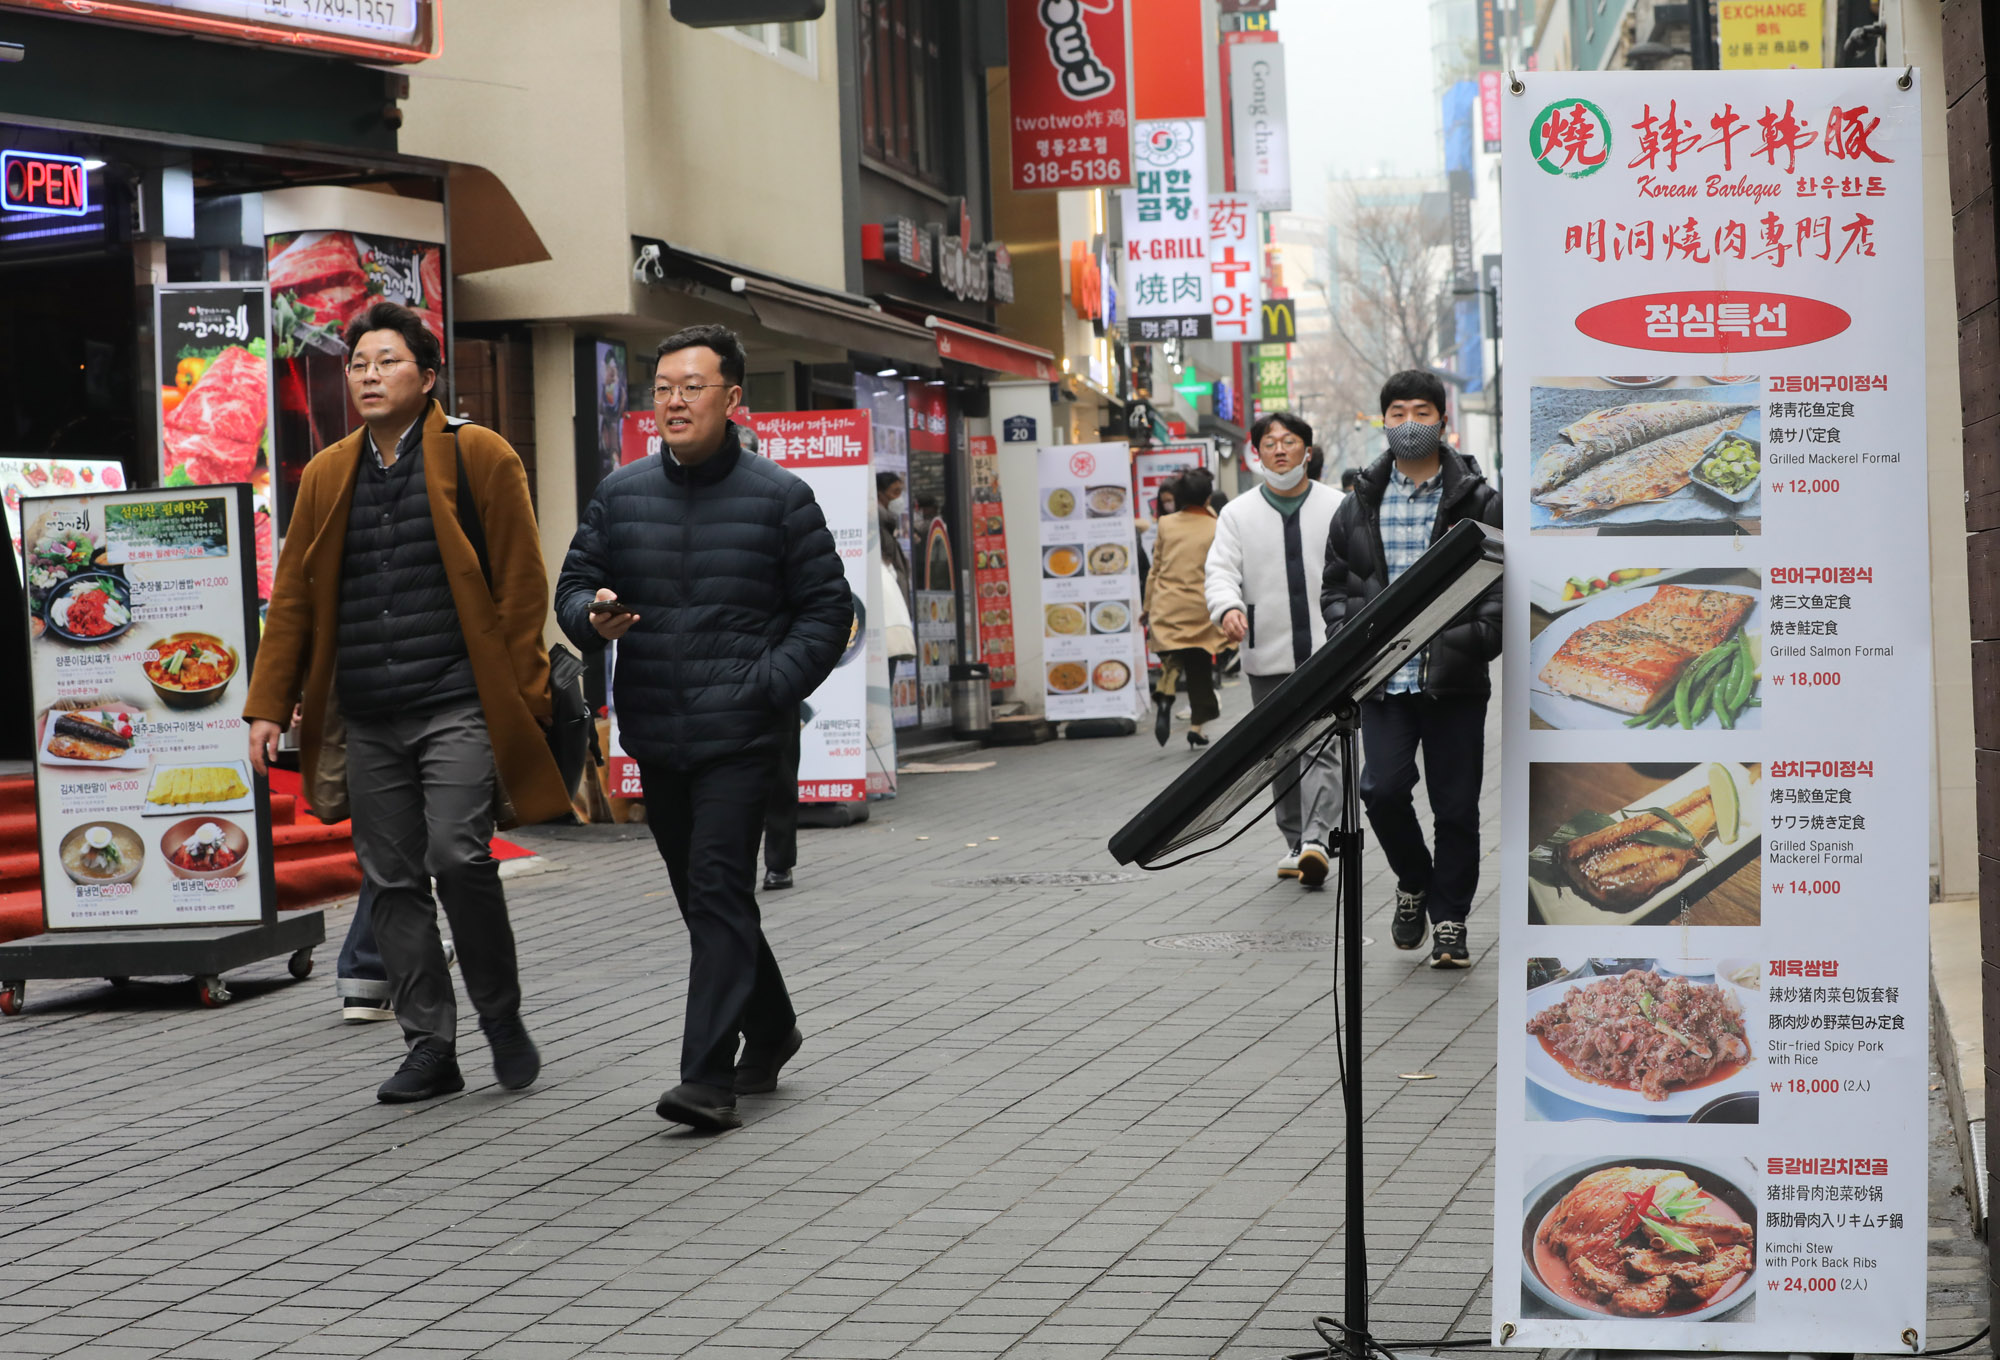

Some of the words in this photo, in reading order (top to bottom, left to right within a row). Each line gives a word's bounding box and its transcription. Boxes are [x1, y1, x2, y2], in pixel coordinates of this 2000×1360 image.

[1723, 2, 1807, 20] EXCHANGE
[1036, 136, 1108, 158] 명동2호점
[1023, 158, 1122, 184] 318-5136
[6, 160, 83, 209] OPEN
[1637, 175, 1699, 199] Korean
[1705, 175, 1782, 204] Barbeque
[1796, 176, 1887, 199] 한우한돈
[1208, 198, 1248, 241] 药
[1128, 237, 1206, 261] K-GRILL
[1212, 292, 1252, 335] 약
[1644, 303, 1788, 338] 점심특선
[1769, 375, 1888, 392] 고등어구이정식
[1012, 428, 1029, 441] 20
[1769, 453, 1805, 465] Grilled
[1809, 453, 1858, 465] Mackerel
[1862, 452, 1900, 464] Formal
[1789, 479, 1840, 494] 12,000
[1770, 567, 1873, 584] 연어구이정식
[131, 579, 194, 593] 고추장불고기쌈밥
[1770, 594, 1851, 610] 烤三文鱼定食
[1770, 646, 1806, 657] Grilled
[1810, 646, 1851, 657] Salmon
[1855, 646, 1894, 657] Formal
[1790, 671, 1841, 688] 18,000
[133, 720, 204, 735] 제주고등어구이정식
[1770, 760, 1874, 778] 삼치구이정식
[60, 782, 107, 795] 김치계란말이
[1770, 814, 1866, 831] サワラ焼き定食
[1770, 840, 1806, 851] Grilled
[1810, 840, 1854, 853] Spanish
[1770, 853, 1820, 864] Mackerel
[1824, 853, 1863, 864] Formal
[76, 886, 99, 898] 물냉면
[172, 880, 205, 892] 비빔냉면
[1789, 880, 1841, 896] 14,000
[1769, 959, 1839, 977] 제육쌈밥
[1769, 986, 1899, 1003] 辣炒猪肉菜包饭套餐
[1768, 1014, 1905, 1030] 豚肉炒め野菜包み定食
[1768, 1040, 1820, 1051] Stir-fried
[1824, 1040, 1854, 1053] Spicy
[1858, 1040, 1884, 1051] Pork
[1768, 1054, 1790, 1065] with
[1794, 1054, 1819, 1065] Rice
[1787, 1079, 1840, 1094] 18,000
[1843, 1079, 1871, 1092] (2人)
[1767, 1157, 1889, 1176] 등갈비김치전골
[1767, 1184, 1883, 1202] 猪排骨肉泡菜砂锅
[1765, 1242, 1802, 1254] Kimchi
[1806, 1243, 1833, 1254] Stew
[1765, 1256, 1787, 1267] with
[1791, 1257, 1818, 1268] Pork
[1822, 1257, 1849, 1268] Back
[1853, 1257, 1877, 1268] Ribs
[1784, 1277, 1837, 1293] 24,000
[1840, 1278, 1868, 1291] (2人)
